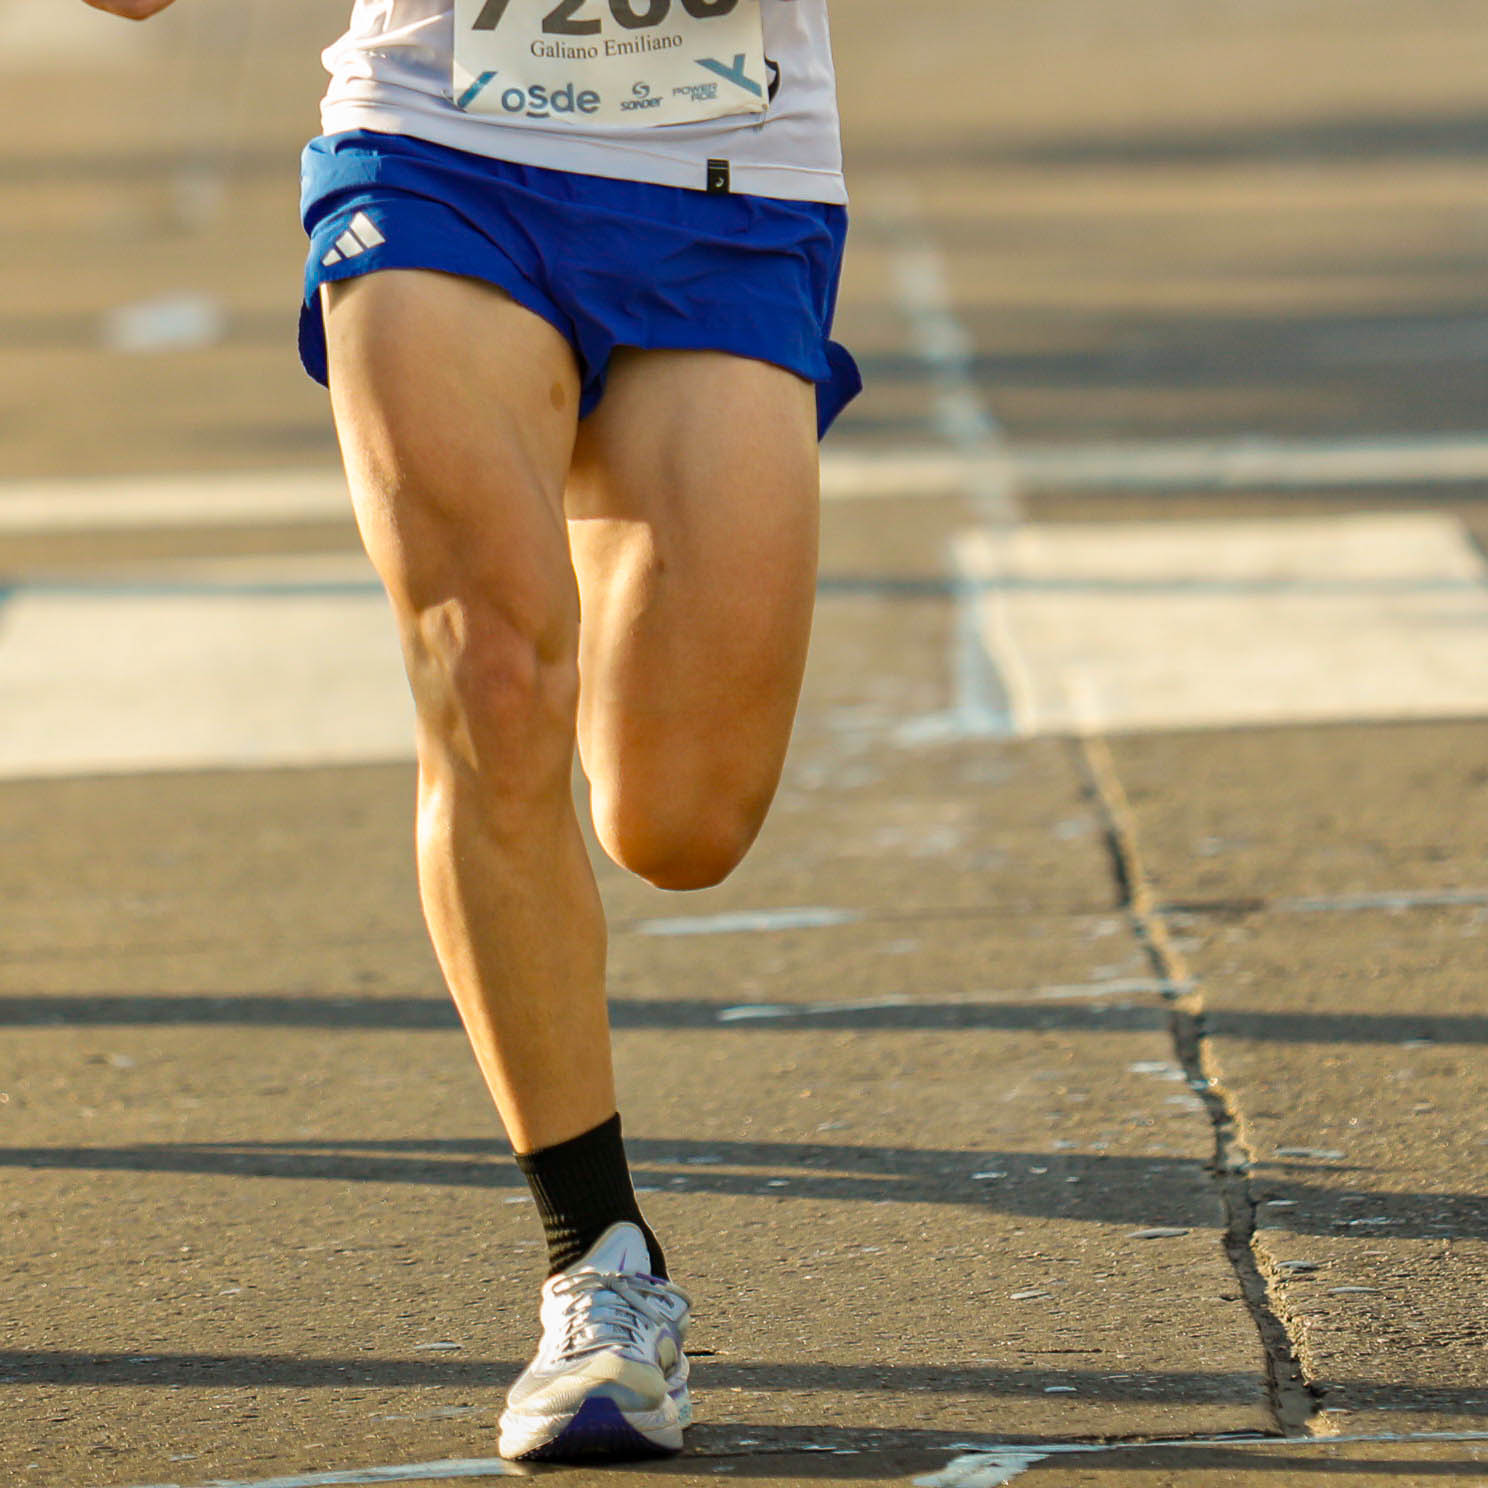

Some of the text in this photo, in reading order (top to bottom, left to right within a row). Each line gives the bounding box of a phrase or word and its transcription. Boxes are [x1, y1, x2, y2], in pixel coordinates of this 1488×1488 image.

[530, 33, 683, 60] Galiano Emiliano
[500, 82, 601, 115] osde
